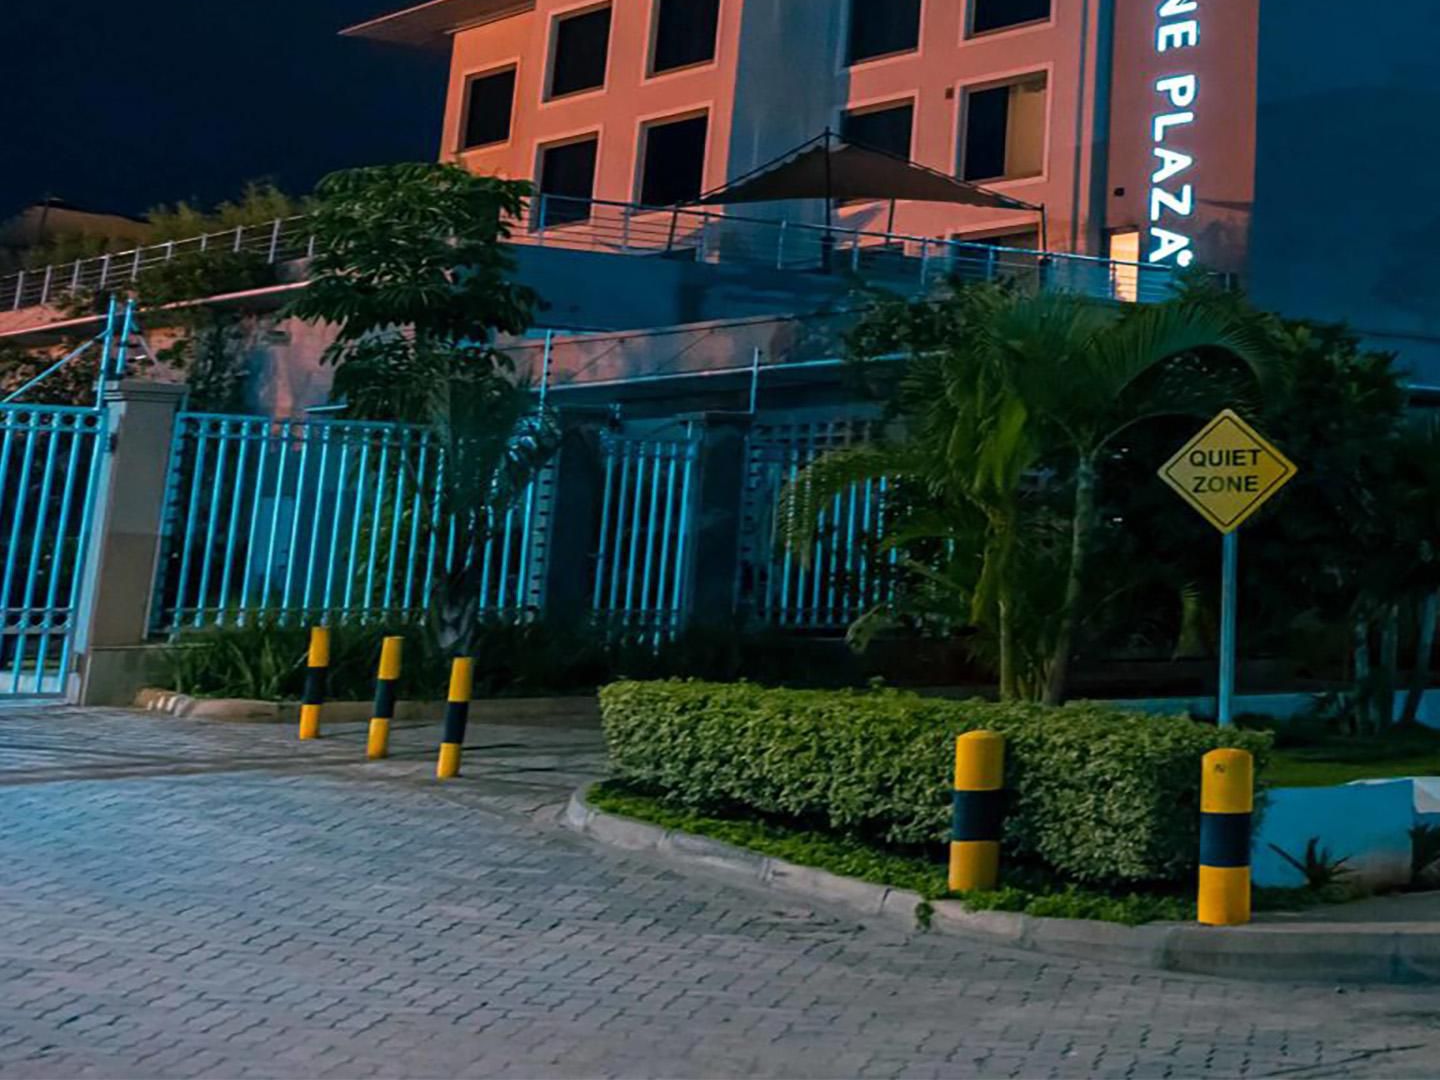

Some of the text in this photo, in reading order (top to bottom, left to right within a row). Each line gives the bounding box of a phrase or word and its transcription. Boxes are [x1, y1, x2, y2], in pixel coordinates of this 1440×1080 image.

[1148, 73, 1196, 266] PLAZA
[1189, 449, 1261, 468] QUIET
[1192, 475, 1259, 493] ZONE
